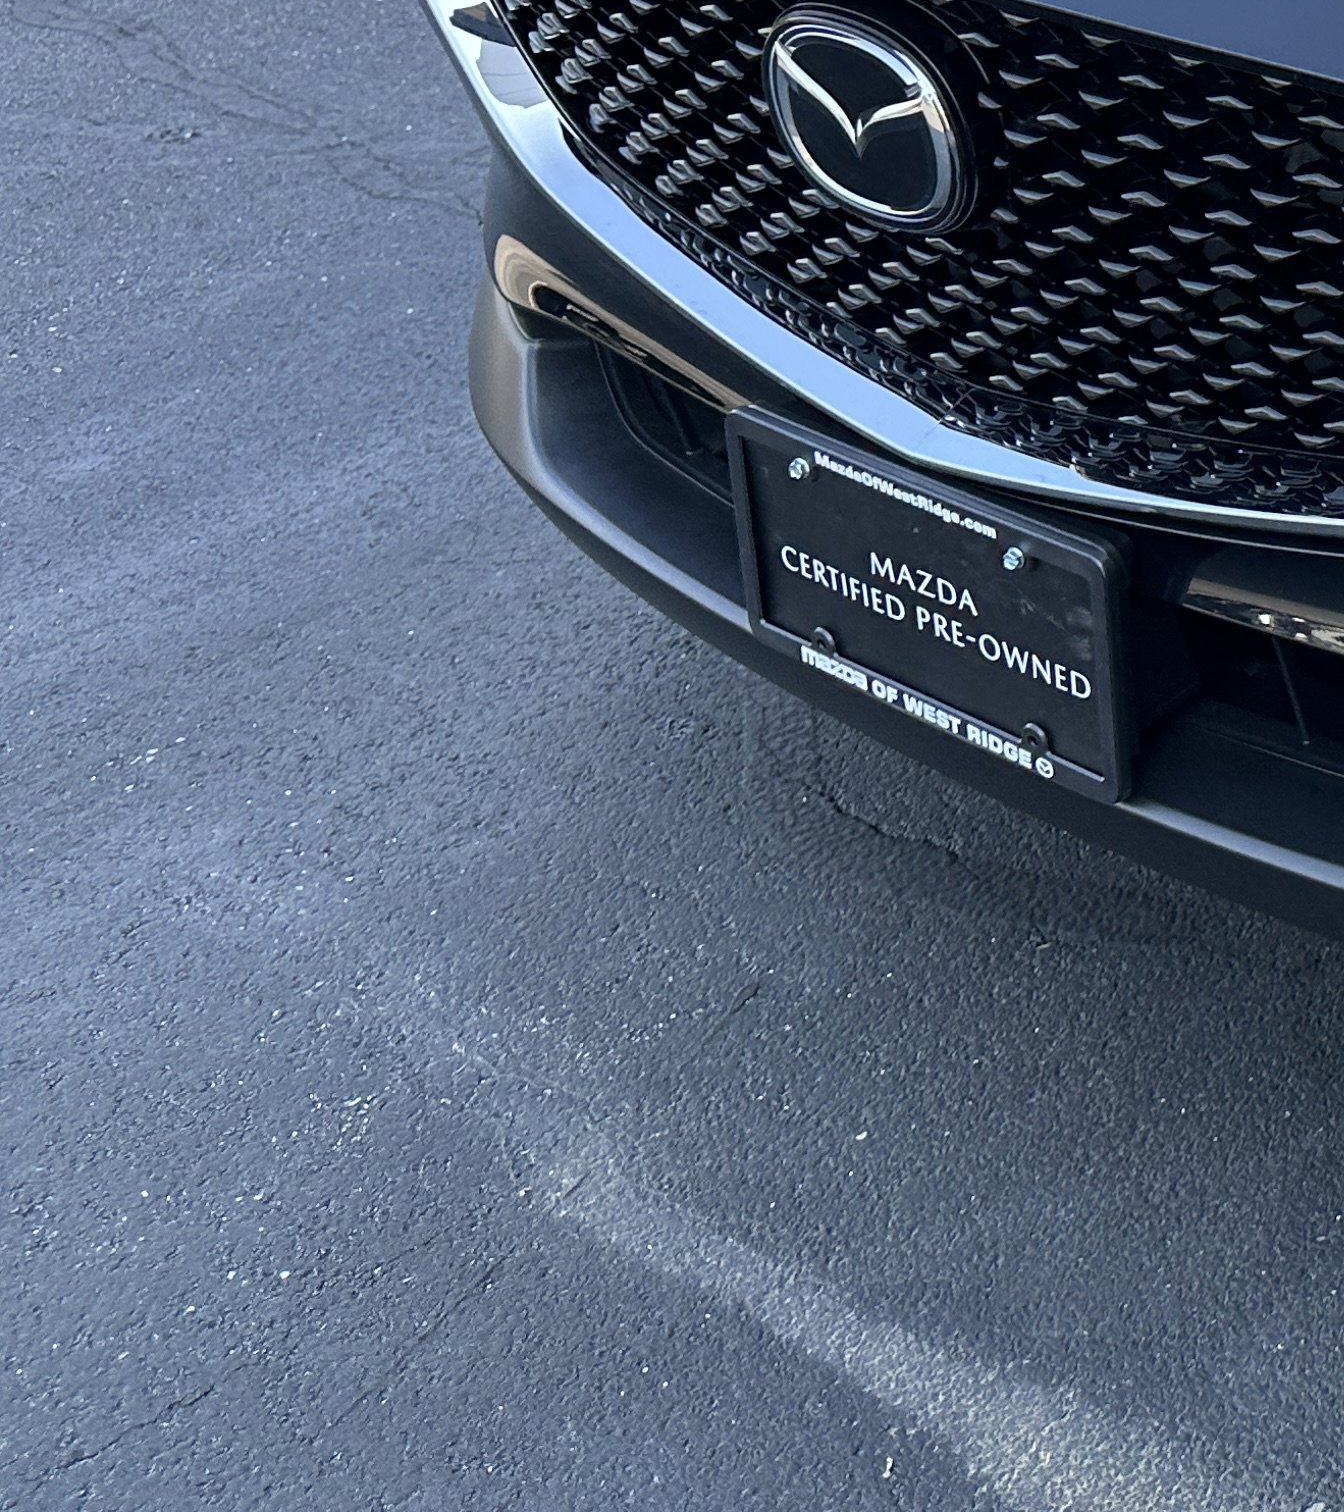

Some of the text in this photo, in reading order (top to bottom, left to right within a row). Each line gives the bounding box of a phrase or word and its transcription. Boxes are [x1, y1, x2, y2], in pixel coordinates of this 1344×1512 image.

[814, 451, 997, 539] MazdaOfWestRidge.com
[780, 545, 1092, 699] CERTIFIED PRE-OWNED
[870, 551, 978, 616] MAZDA
[872, 680, 898, 703] OF
[902, 694, 961, 734] WEST
[966, 723, 1032, 769] RIDGE
